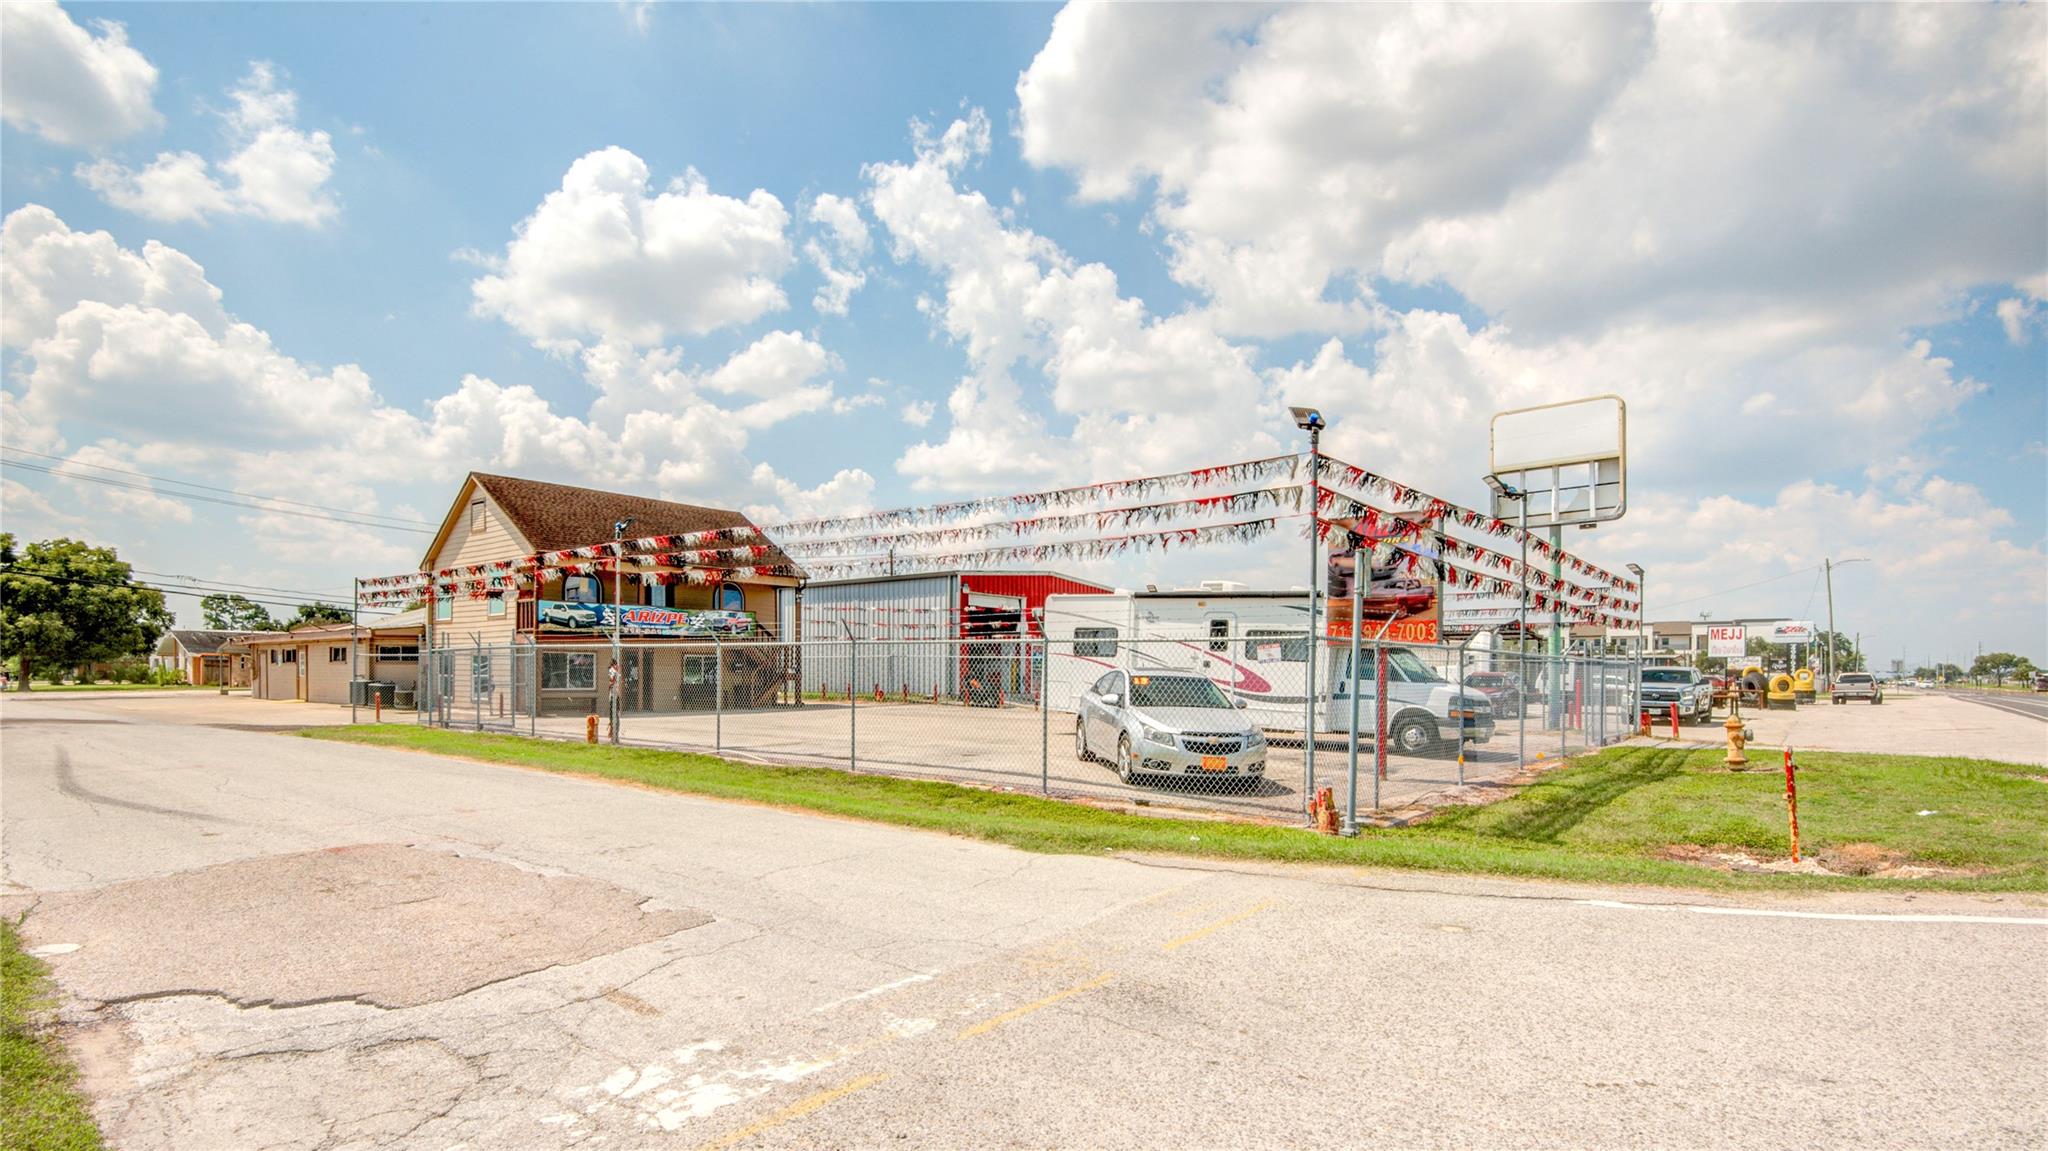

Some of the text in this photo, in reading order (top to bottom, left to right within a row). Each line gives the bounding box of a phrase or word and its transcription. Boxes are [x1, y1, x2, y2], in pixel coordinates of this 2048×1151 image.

[624, 609, 688, 625] ARIZPE
[1330, 622, 1437, 641] 71944-7003
[1711, 628, 1742, 640] MEJJ
